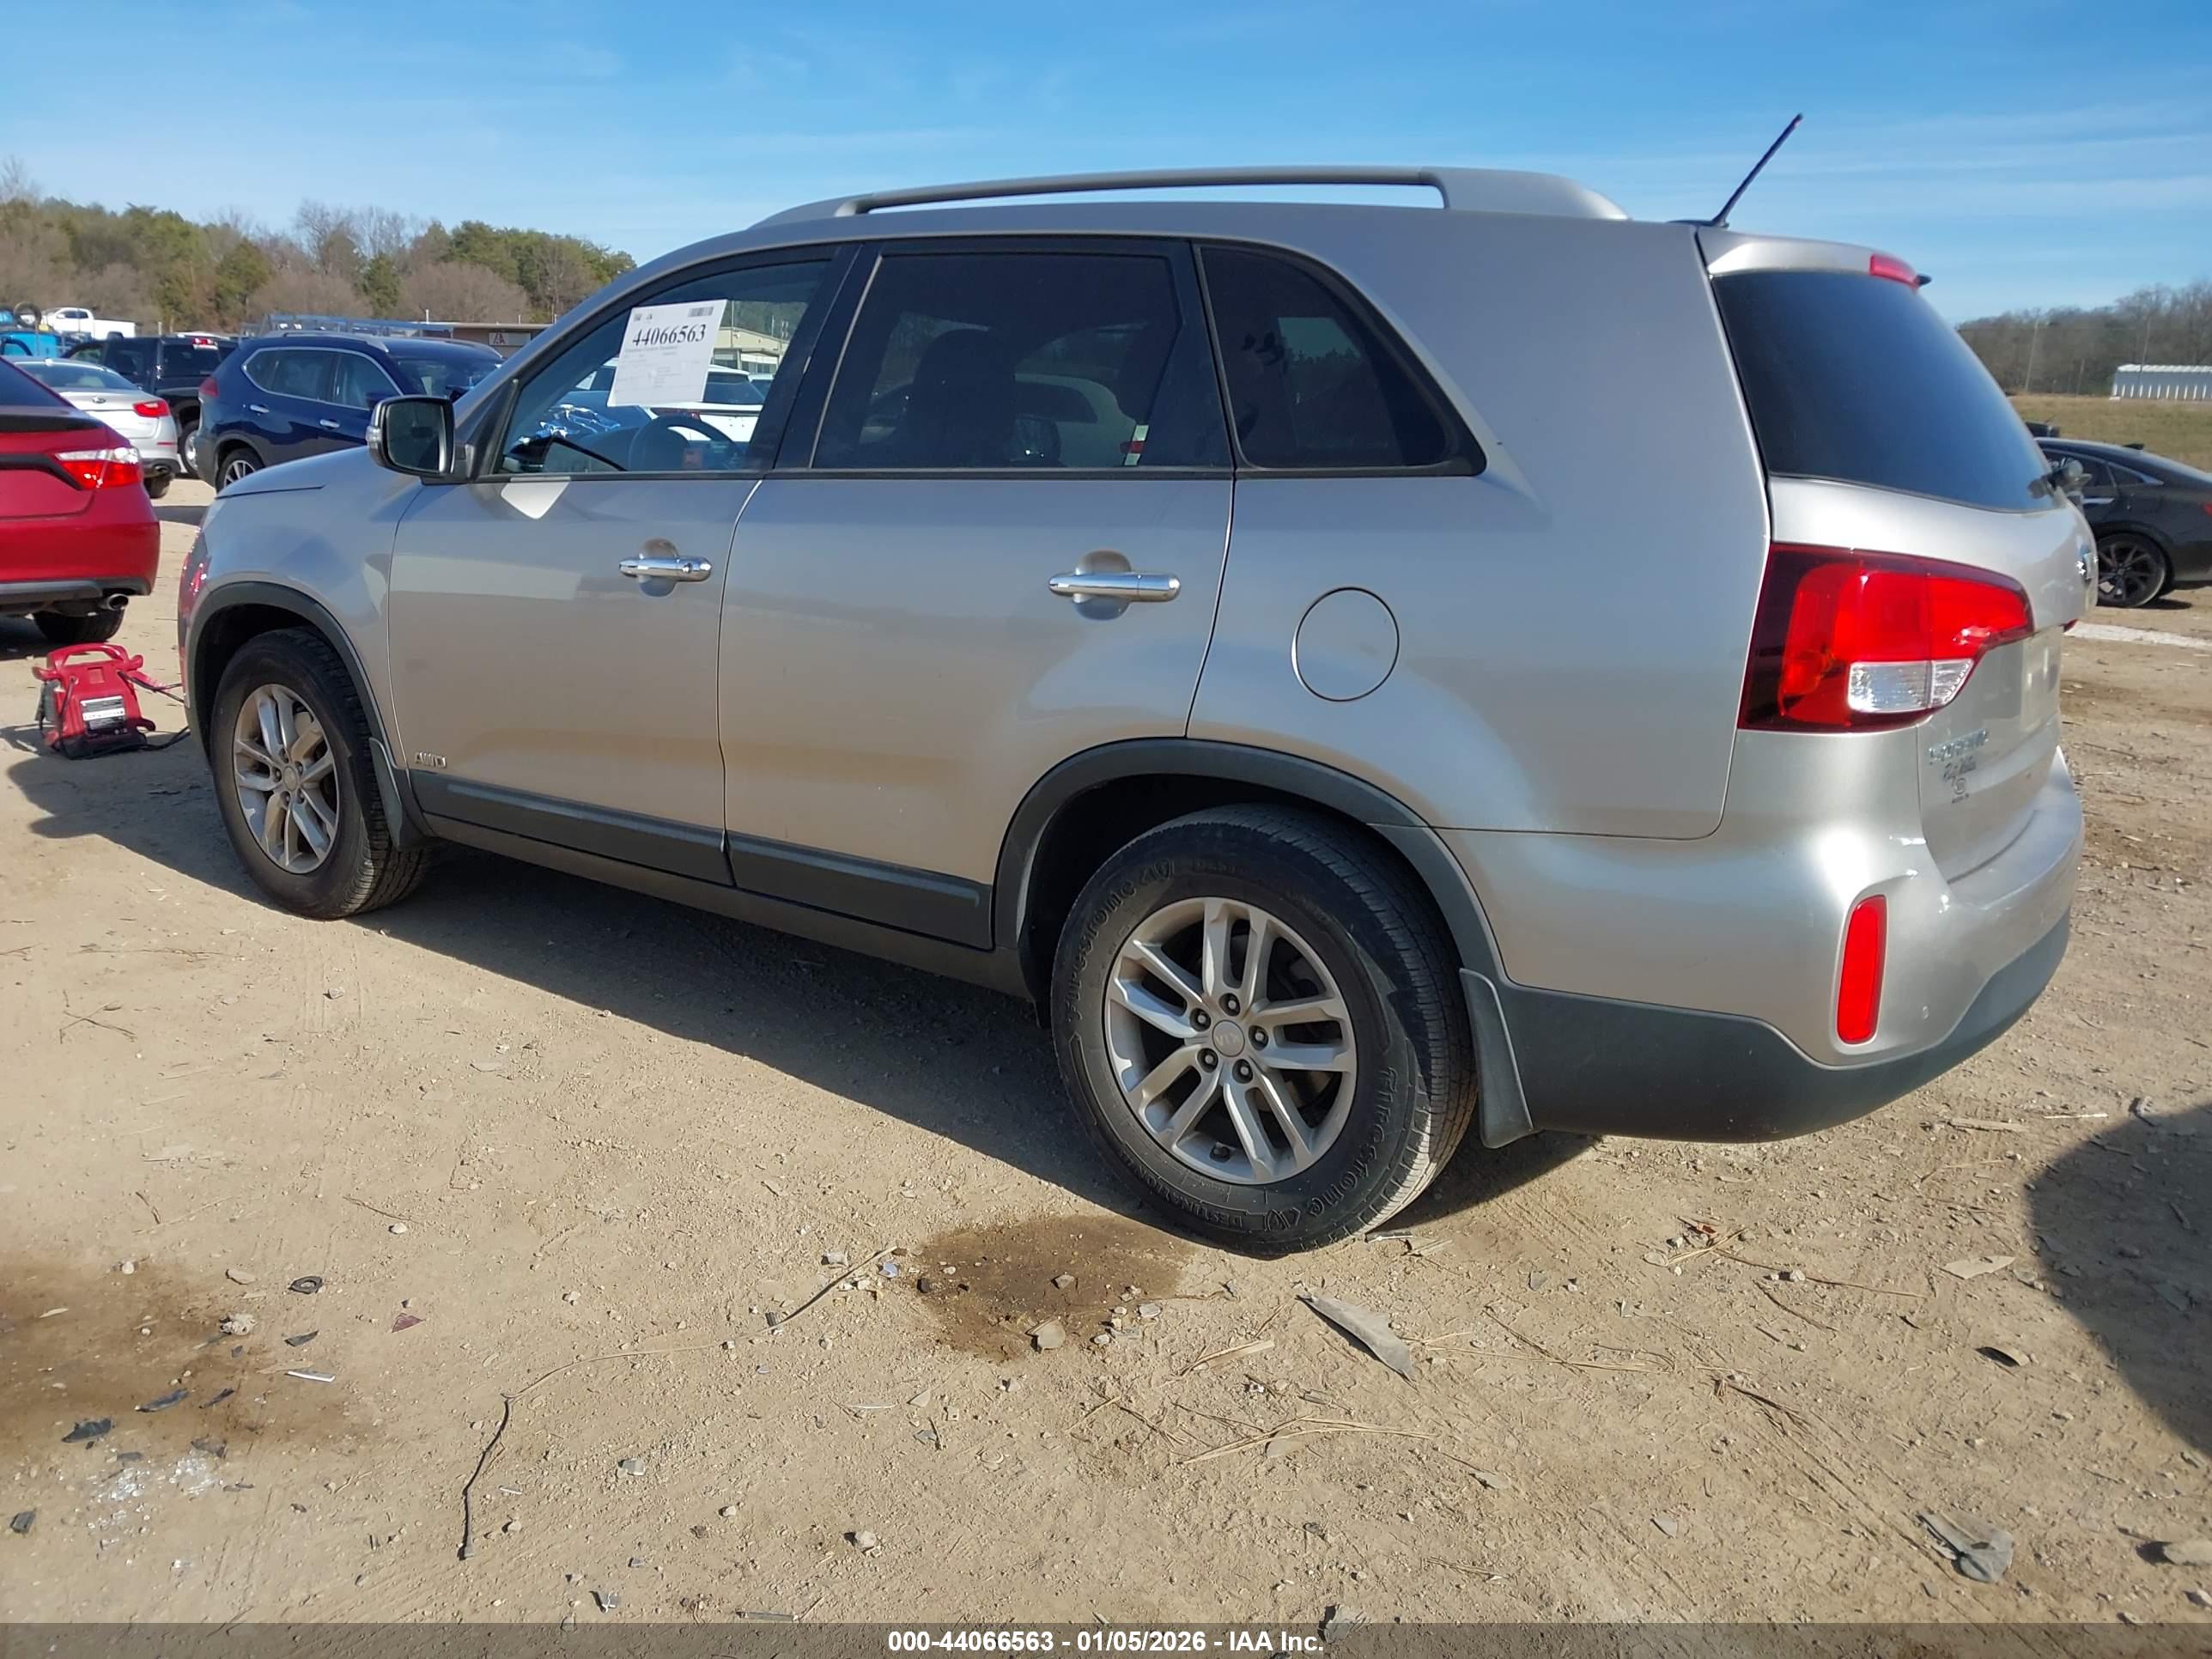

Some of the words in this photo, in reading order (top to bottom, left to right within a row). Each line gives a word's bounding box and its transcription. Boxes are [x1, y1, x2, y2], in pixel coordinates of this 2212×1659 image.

[632, 324, 707, 347] 44066563
[1066, 877, 1138, 1023] Firestone
[1310, 1066, 1398, 1218] Firestone
